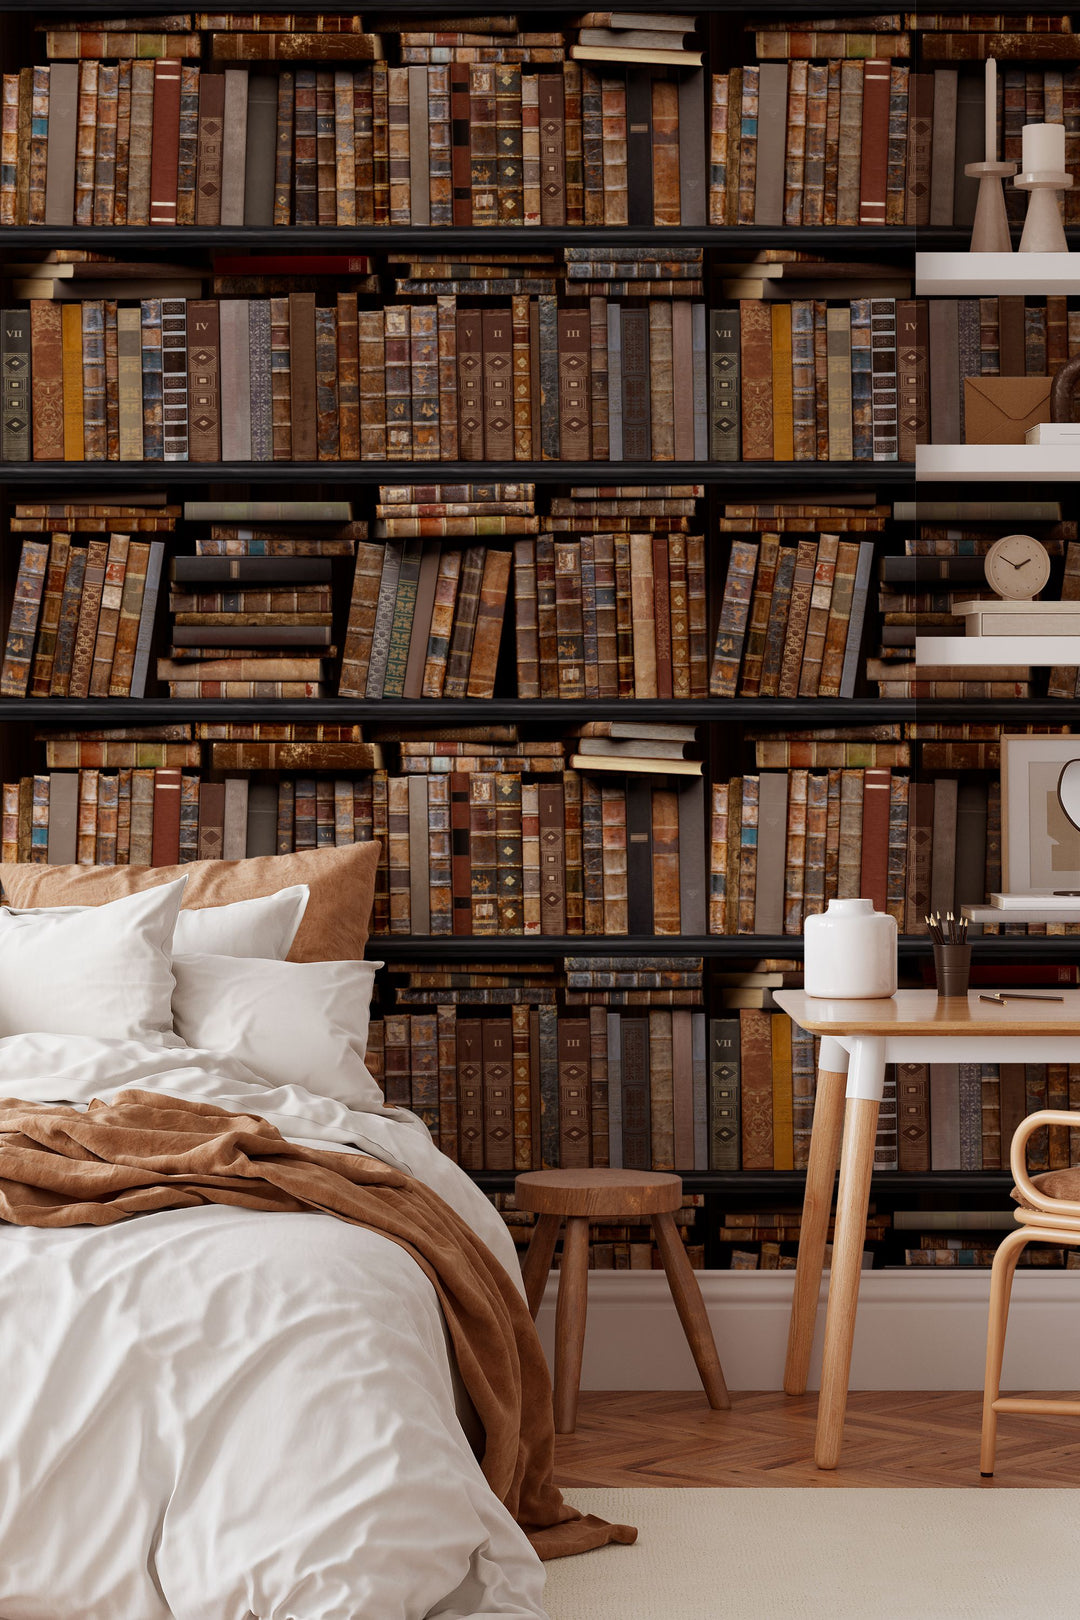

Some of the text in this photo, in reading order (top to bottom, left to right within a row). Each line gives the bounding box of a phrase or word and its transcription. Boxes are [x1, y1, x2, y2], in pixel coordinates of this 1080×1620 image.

[195, 322, 208, 331] IV
[904, 322, 917, 331] IV
[6, 330, 22, 338] VII
[493, 330, 503, 338] II
[566, 330, 581, 338] III
[715, 330, 731, 338] VII
[465, 1039, 473, 1047] V
[493, 1039, 503, 1047] II
[566, 1039, 581, 1047] III
[715, 1039, 731, 1047] VII
